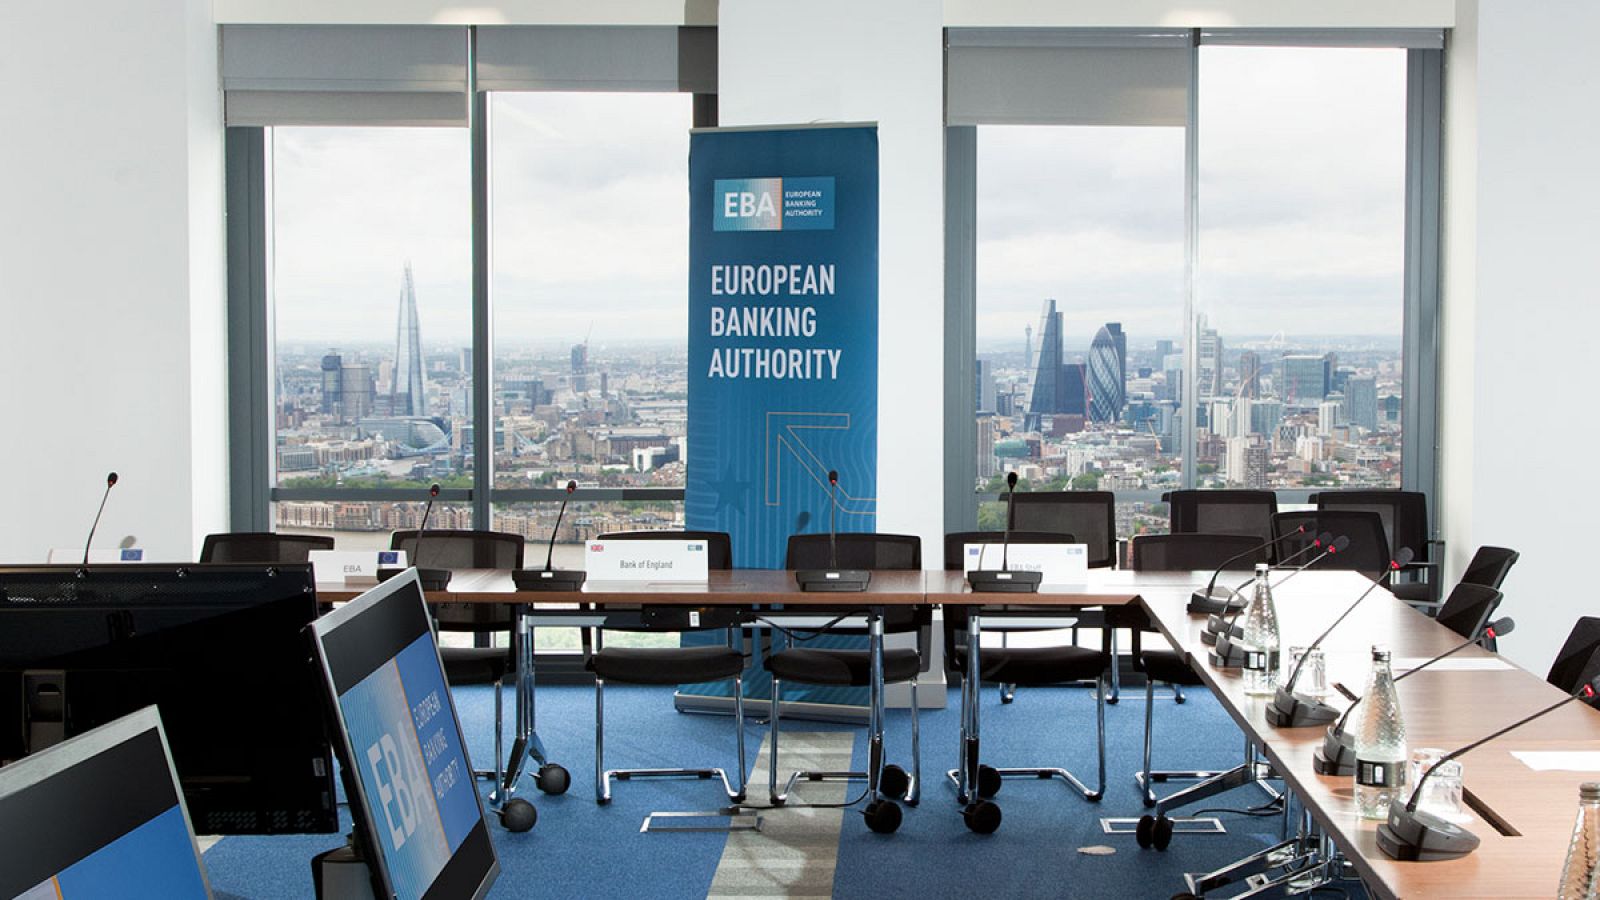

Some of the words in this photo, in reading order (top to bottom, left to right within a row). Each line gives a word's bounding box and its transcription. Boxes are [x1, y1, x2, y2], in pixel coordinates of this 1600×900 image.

[724, 192, 777, 218] EBA
[785, 190, 822, 198] EUROPEAN
[785, 199, 817, 208] BANKING
[785, 209, 823, 217] AUTHORITY
[711, 264, 836, 295] EUROPEAN
[710, 306, 817, 337] BANKING
[708, 348, 842, 379] AUTHORITY
[343, 564, 362, 573] EBA
[620, 560, 637, 569] Bank
[646, 560, 672, 570] England
[413, 690, 441, 730] EUROPEAN
[423, 727, 449, 766] BANKING
[367, 718, 433, 851] EBA
